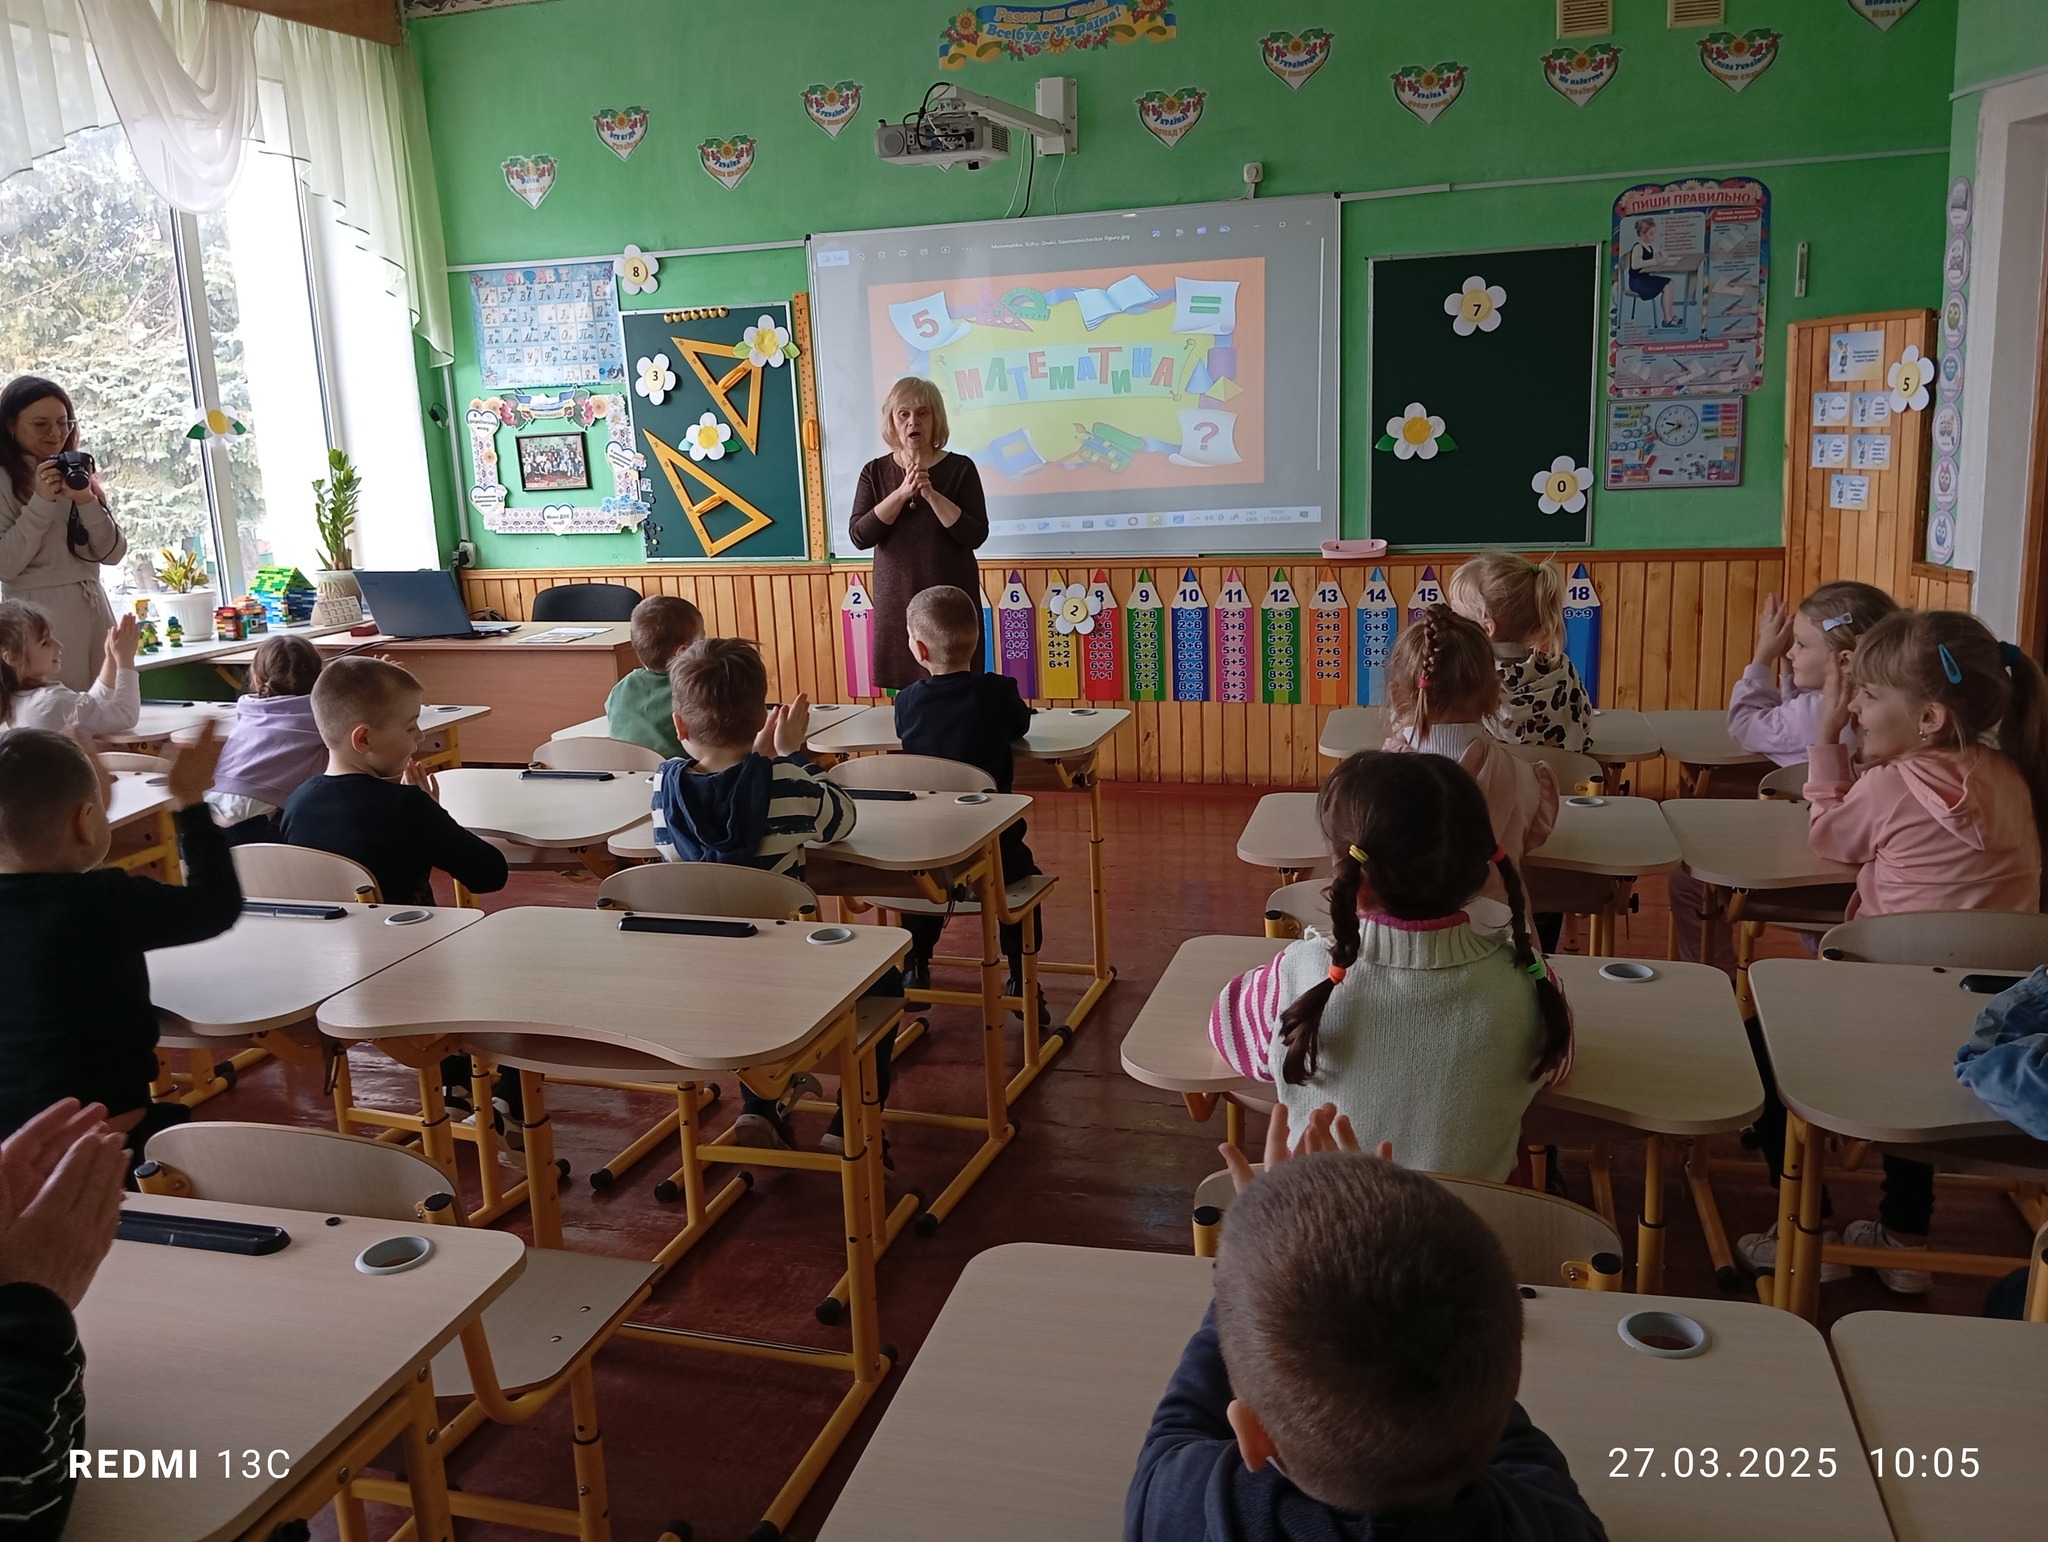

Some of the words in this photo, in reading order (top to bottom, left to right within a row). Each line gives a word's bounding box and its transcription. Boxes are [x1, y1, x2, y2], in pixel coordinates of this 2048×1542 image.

[986, 23, 1016, 40] Все
[1014, 30, 1049, 43] буде
[1053, 6, 1121, 39] Україна!
[1632, 195, 1670, 211] ПИШИ
[1674, 192, 1750, 204] ПРАВИЛЬНО
[633, 267, 639, 278] 8
[1473, 304, 1481, 317] 7
[911, 309, 939, 338] 5
[653, 371, 659, 381] 3
[955, 347, 1174, 400] МАТЕМАТИКА
[1903, 378, 1910, 391] 5
[1193, 421, 1219, 451] ?
[1557, 480, 1567, 492] 0
[852, 592, 861, 604] 2
[1010, 590, 1020, 603] 6
[1139, 589, 1150, 602] 9
[1179, 589, 1199, 602] 10
[1225, 589, 1243, 602] 11
[1270, 589, 1290, 602] 12
[1318, 589, 1338, 603] 13
[1366, 589, 1387, 603] 14
[1417, 589, 1438, 602] 15
[1568, 586, 1590, 601] 18
[1005, 610, 1027, 619] 1+5
[1070, 605, 1079, 616] 2
[1134, 611, 1156, 619] 1+8
[1178, 611, 1201, 619] 1+9
[1222, 611, 1245, 619] 2+9
[1268, 611, 1292, 619] 3+9
[1565, 609, 1593, 619] 9+9
[1316, 611, 1340, 620] 4+9
[1365, 611, 1389, 620] 5+9
[1005, 621, 1028, 629] 2+4
[1134, 621, 1156, 629] 2+7
[1178, 621, 1201, 629] 2+8
[1222, 623, 1245, 631] 3+8
[1268, 623, 1292, 631] 4+8
[1316, 623, 1341, 632] 5+8
[1364, 623, 1389, 632] 6+8
[1006, 631, 1028, 639] 3+3
[1134, 631, 1157, 639] 3+6
[1178, 631, 1202, 639] 3+7
[1222, 634, 1245, 642] 4+7
[1268, 635, 1292, 643] 5+7
[1316, 635, 1340, 644] 6+7
[1365, 635, 1389, 644] 7+7
[1006, 641, 1028, 649] 4+2
[1135, 641, 1157, 649] 4+5
[1178, 641, 1202, 649] 4+6
[1223, 646, 1245, 654] 5+6
[1268, 646, 1292, 654] 6+6
[1317, 647, 1341, 656] 7+6
[1364, 647, 1389, 656] 8+6
[1007, 651, 1028, 659] 5+1
[1135, 652, 1158, 660] 5+4
[1179, 651, 1202, 660] 5+5
[1091, 661, 1113, 670] 6+2
[1135, 662, 1158, 670] 6+3
[1179, 661, 1202, 670] 6+4
[1223, 658, 1246, 666] 6+5
[1268, 658, 1292, 666] 7+5
[1317, 659, 1341, 668] 8+5
[1091, 672, 1112, 680] 7+1
[1135, 672, 1158, 680] 7+2
[1179, 672, 1202, 680] 7+3
[1223, 670, 1246, 678] 7+4
[1269, 670, 1293, 678] 8+4
[1316, 671, 1341, 680] 9+4
[1136, 682, 1158, 690] 8+1
[1179, 682, 1203, 690] 8+2
[1223, 681, 1246, 690] 8+3
[1269, 682, 1293, 690] 9+3
[1180, 692, 1202, 701] 9+1
[1223, 693, 1246, 701] 9+2
